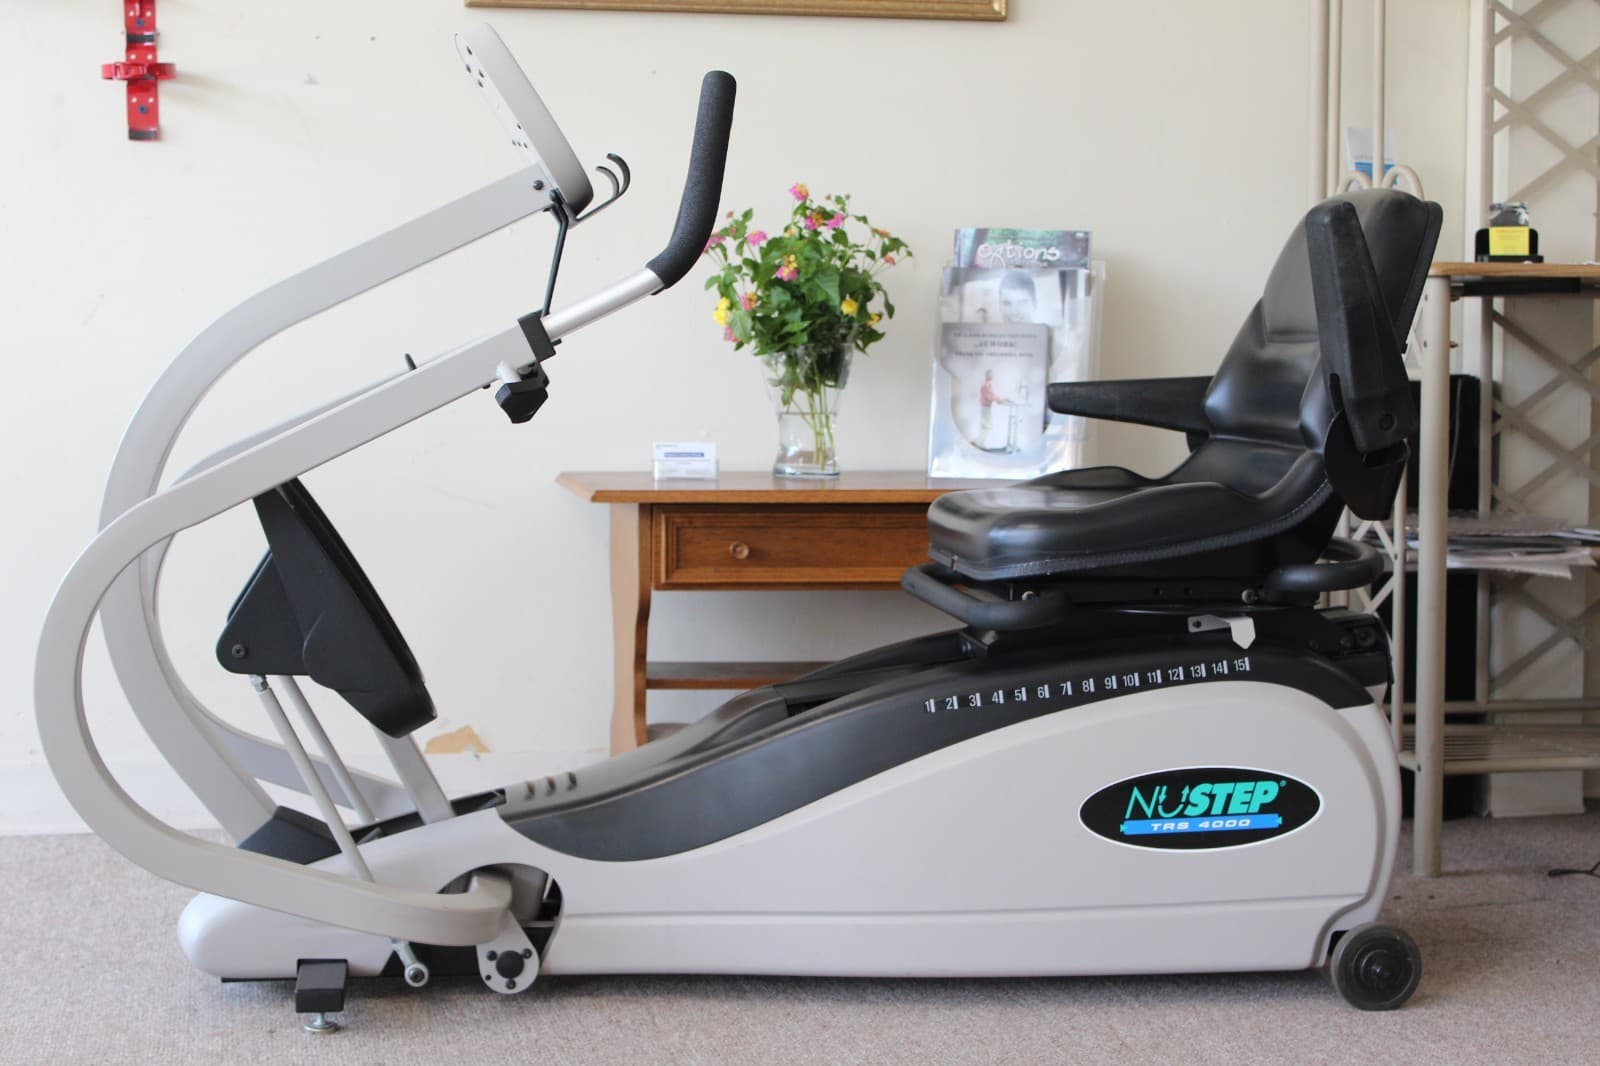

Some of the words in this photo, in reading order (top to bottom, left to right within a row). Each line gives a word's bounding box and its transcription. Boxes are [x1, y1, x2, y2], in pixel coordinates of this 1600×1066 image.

[1122, 674, 1135, 686] 10
[1146, 672, 1157, 683] 11
[1167, 669, 1179, 681] 12
[1189, 666, 1201, 678] 13
[1211, 663, 1223, 674] 14
[1233, 660, 1245, 672] 15
[1151, 821, 1189, 831] TRS
[1198, 818, 1250, 829] 4000
